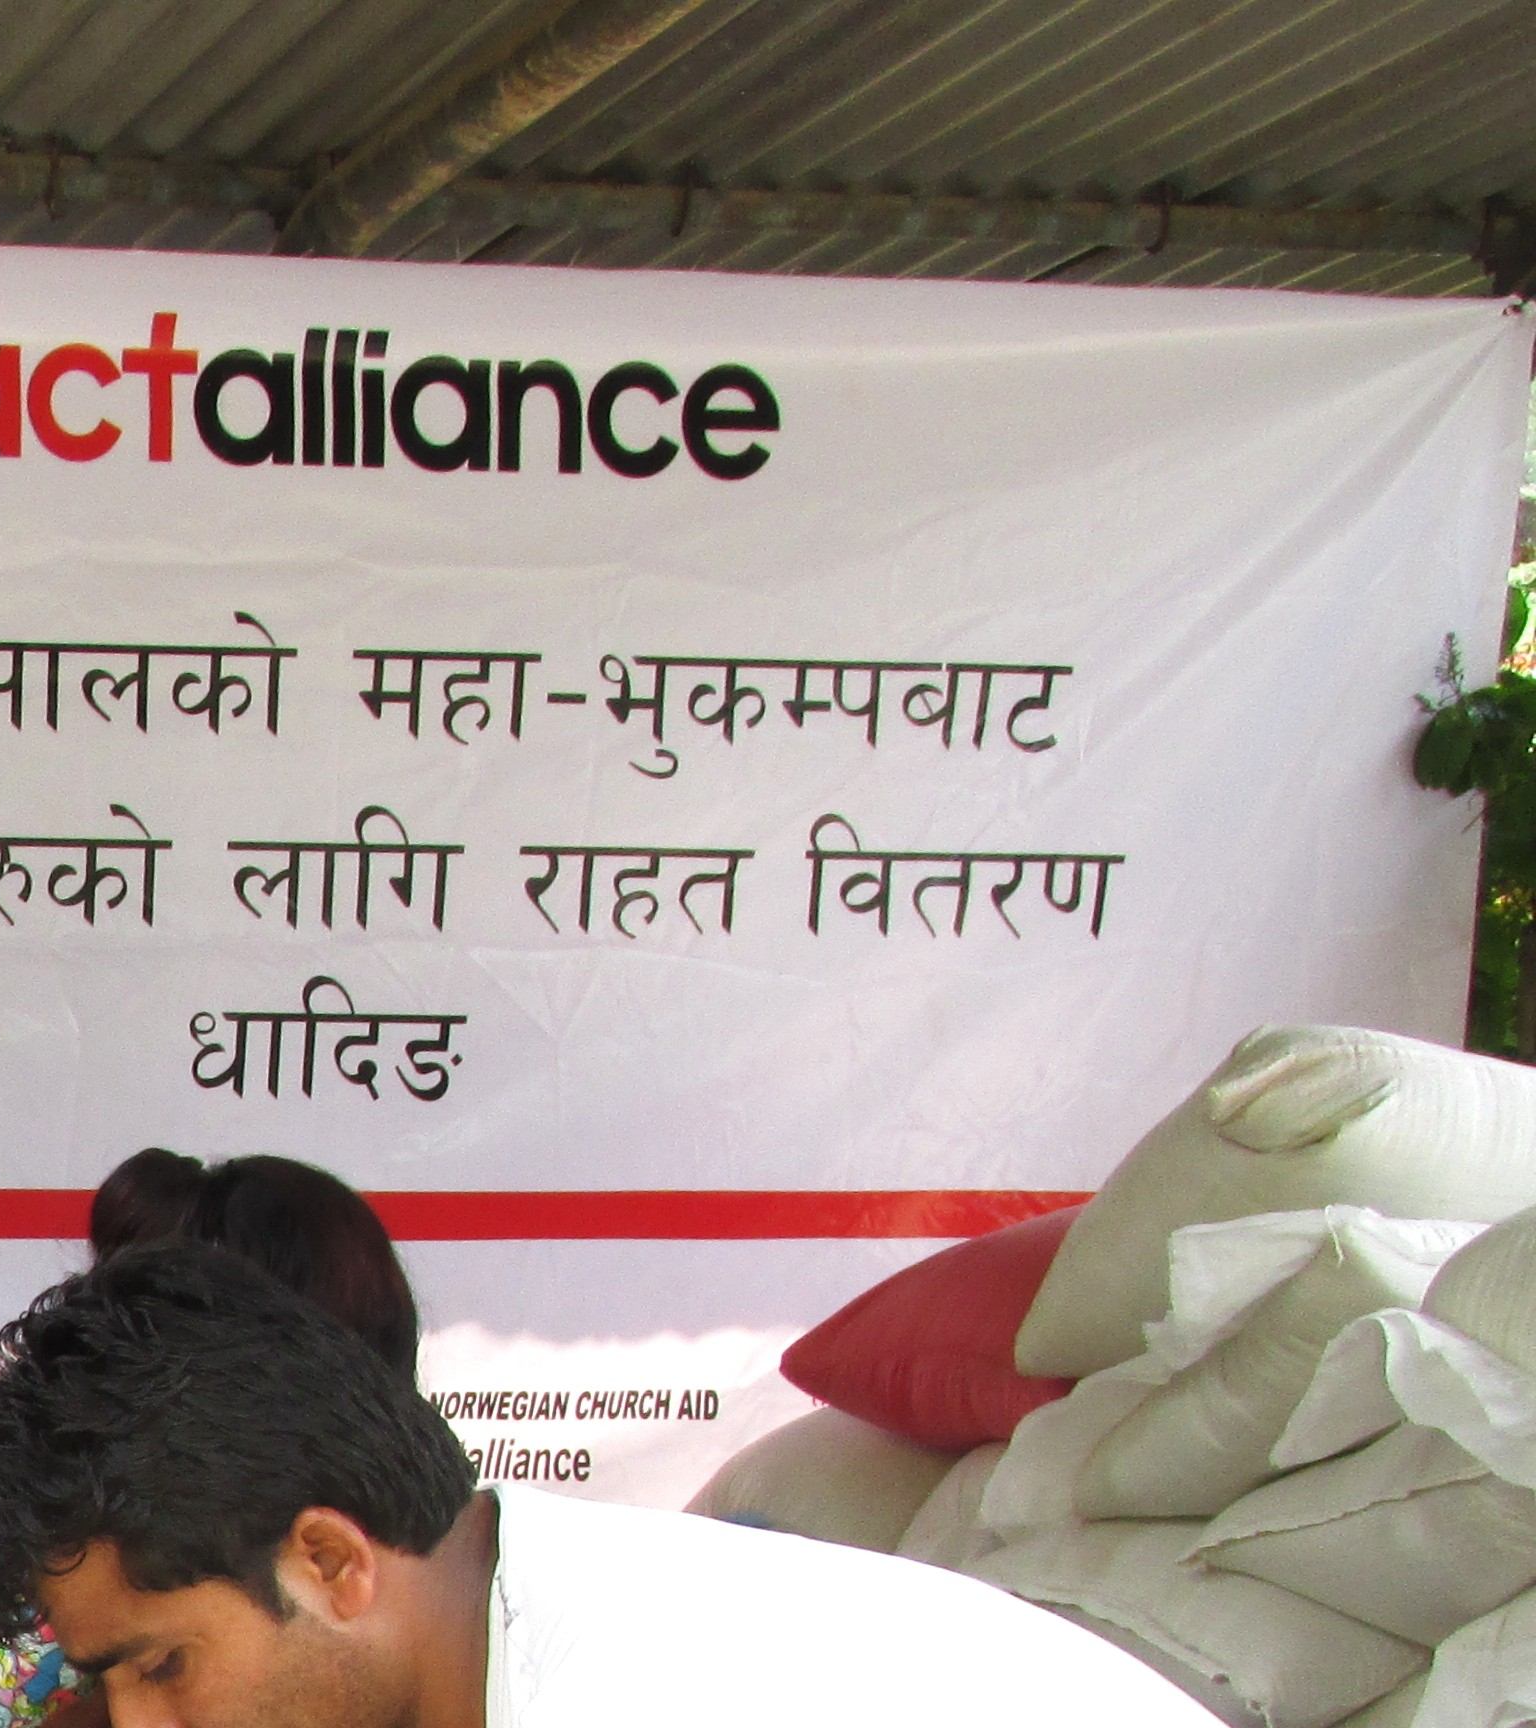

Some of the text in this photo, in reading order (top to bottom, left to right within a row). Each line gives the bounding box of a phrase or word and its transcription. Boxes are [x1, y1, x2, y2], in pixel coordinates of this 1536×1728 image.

[352, 649, 1073, 779] महा-भुकम्पबाट
[227, 805, 465, 932] लागि
[519, 846, 755, 933] राहत
[805, 813, 1125, 938] वितरण
[189, 975, 468, 1102] धादिङ
[430, 1389, 719, 1420] NORWEGIAN CHURCH AID
